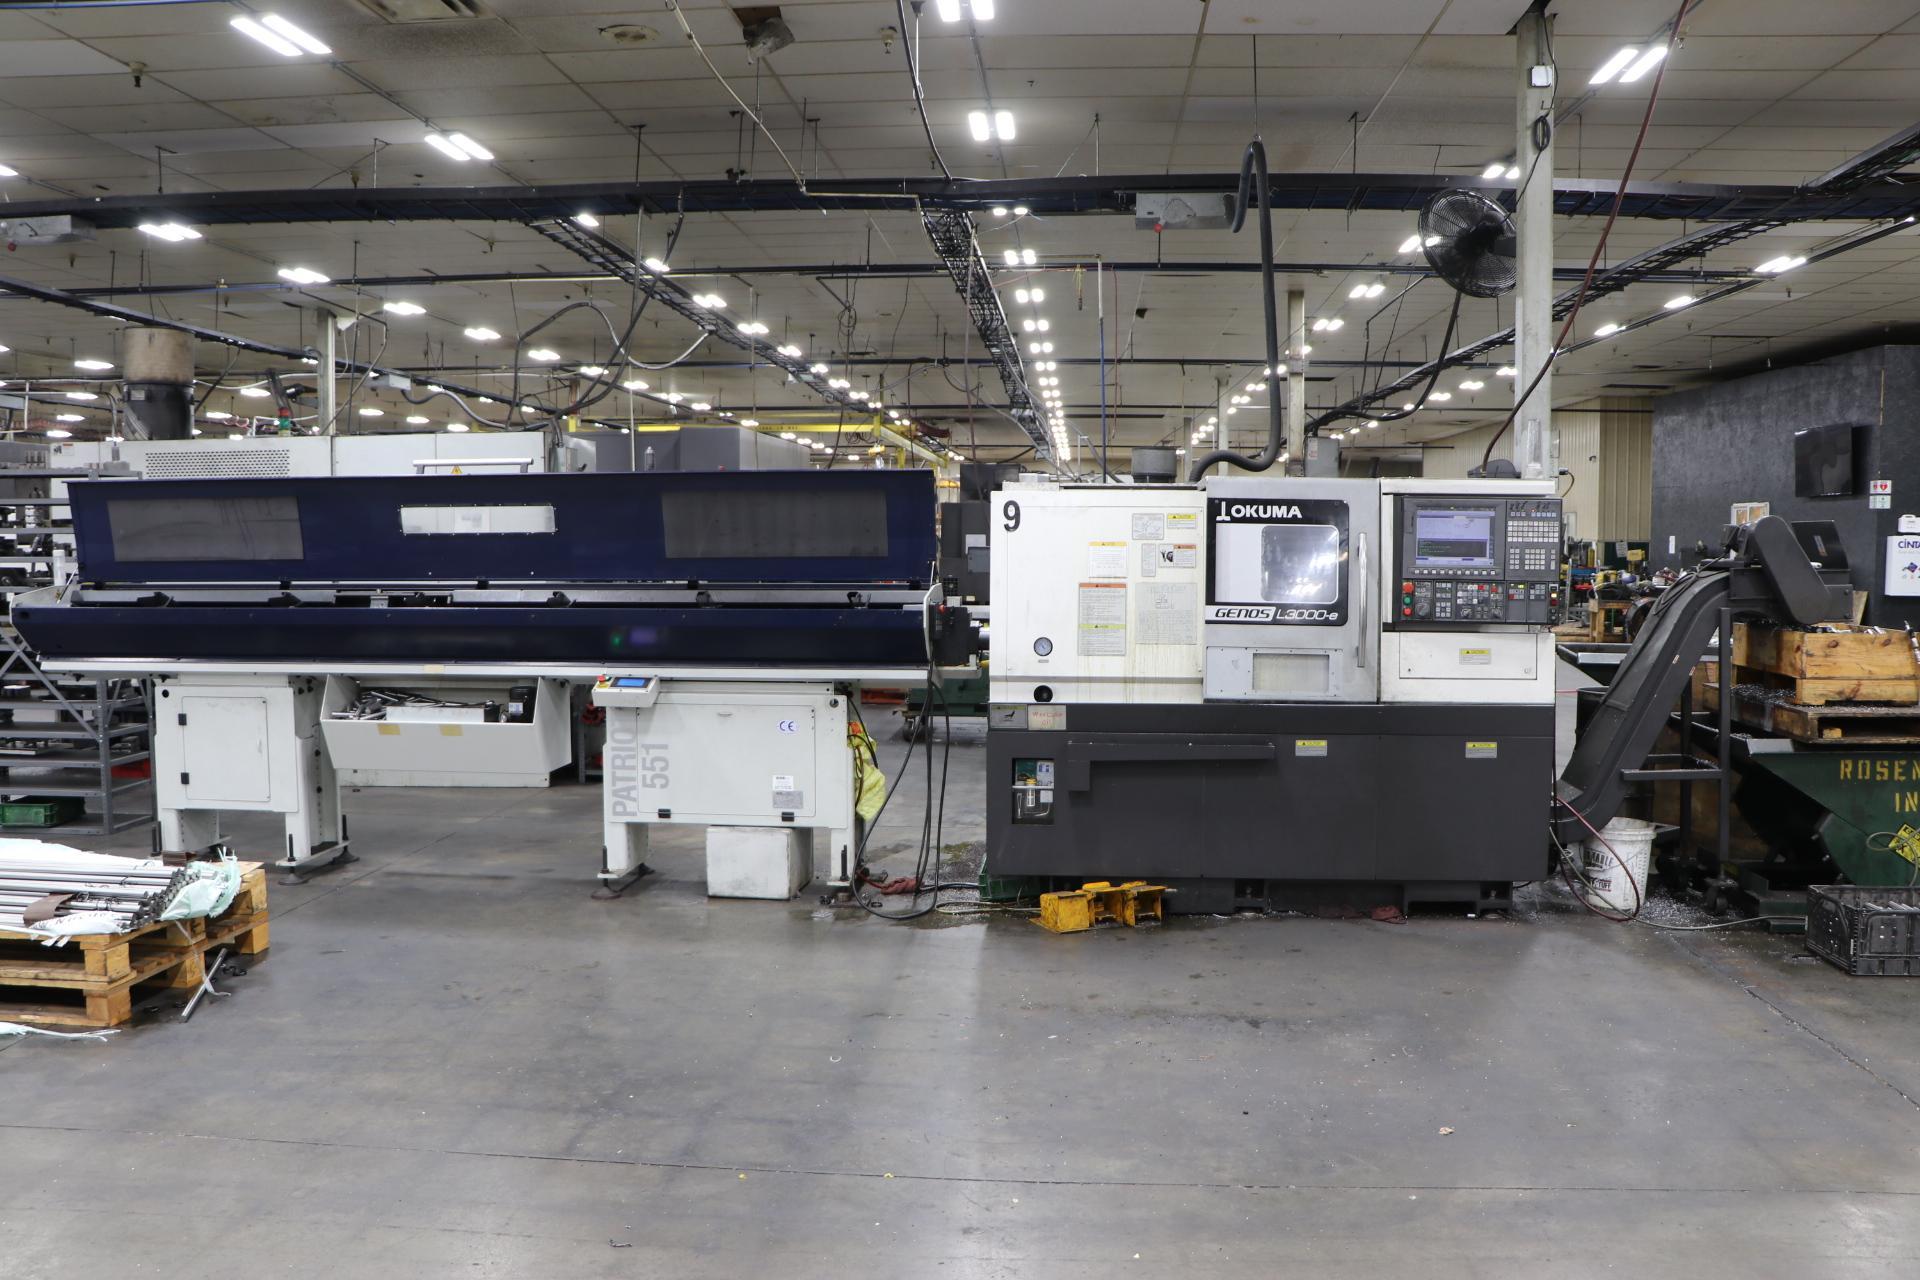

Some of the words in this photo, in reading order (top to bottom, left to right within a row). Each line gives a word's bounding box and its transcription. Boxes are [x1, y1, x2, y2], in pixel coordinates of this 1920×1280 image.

[1004, 500, 1020, 532] 9
[1230, 504, 1303, 518] OKUMA
[1215, 607, 1272, 619] GENOS
[1276, 608, 1339, 620] L3000-e
[641, 743, 670, 789] 551
[1840, 759, 1920, 781] ROSEN
[1895, 791, 1919, 812] IN
